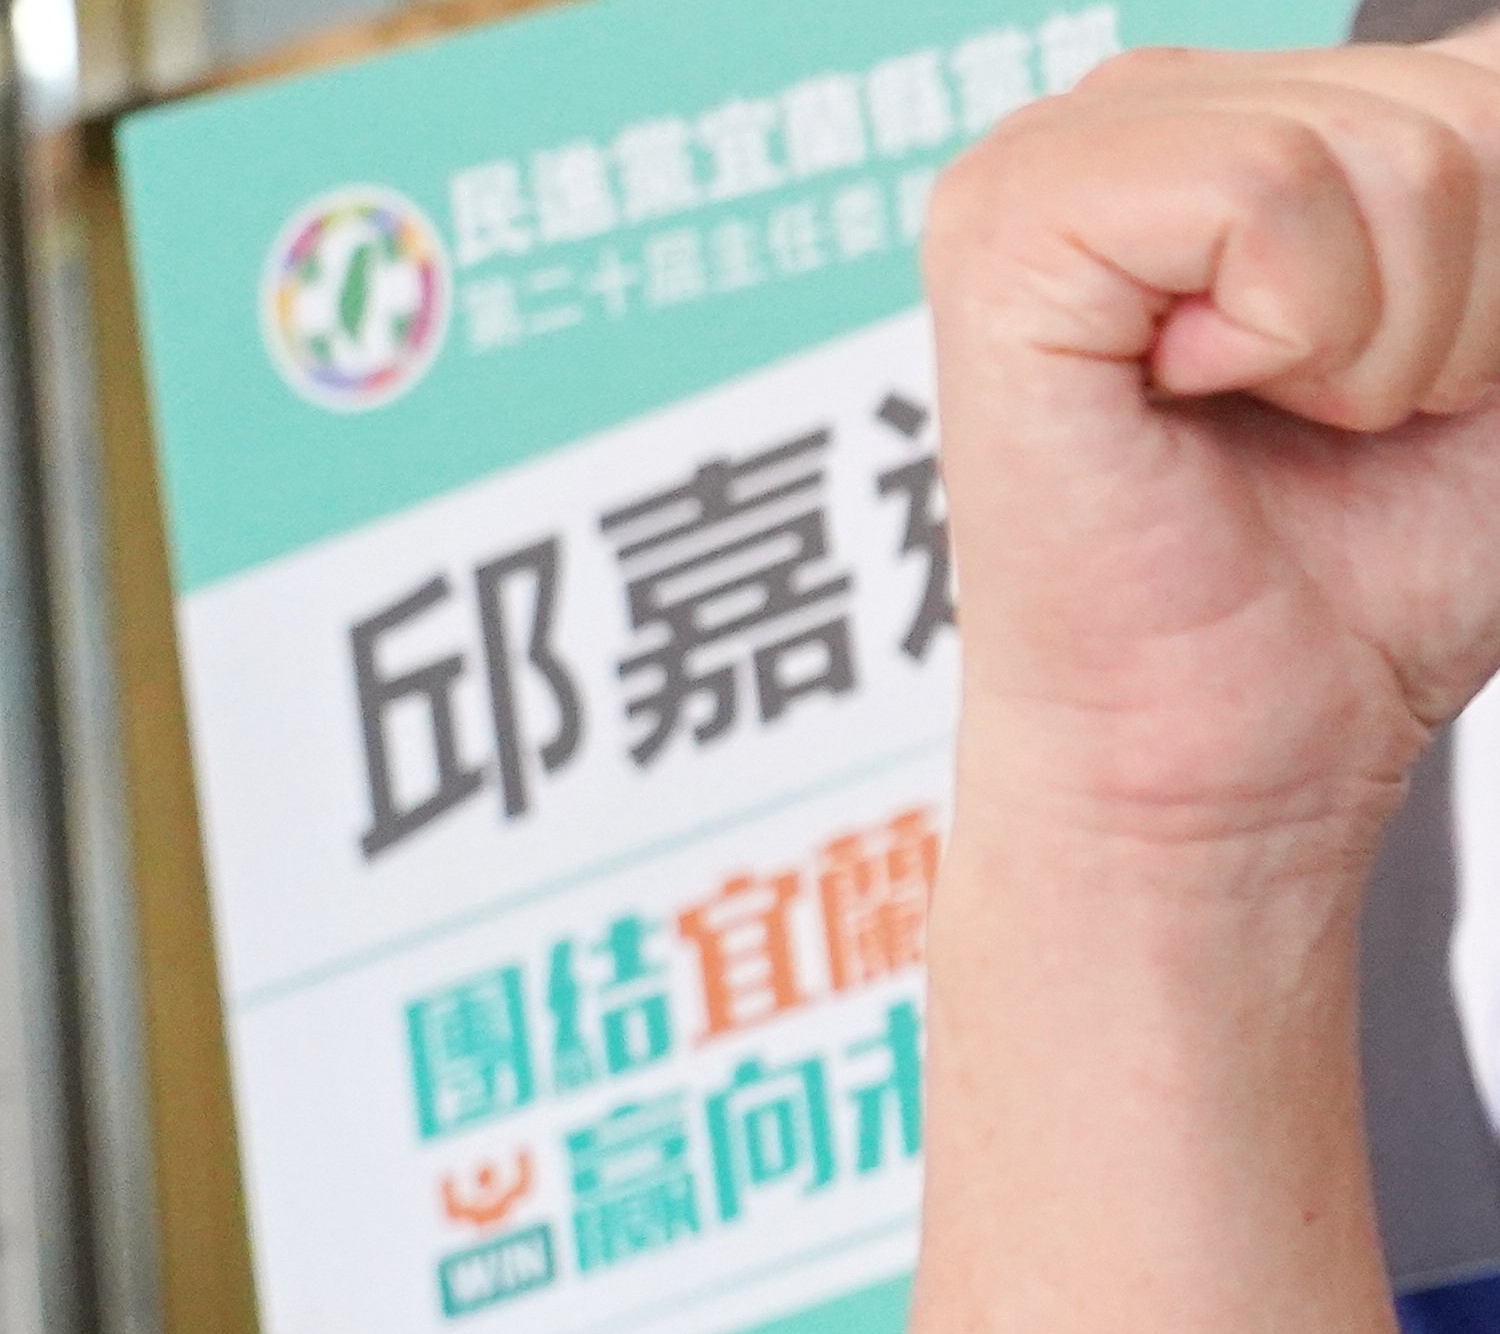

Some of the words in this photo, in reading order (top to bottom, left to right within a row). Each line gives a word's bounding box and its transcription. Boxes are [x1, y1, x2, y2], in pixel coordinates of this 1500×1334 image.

[463, 166, 930, 355] 第二十屆主任委
